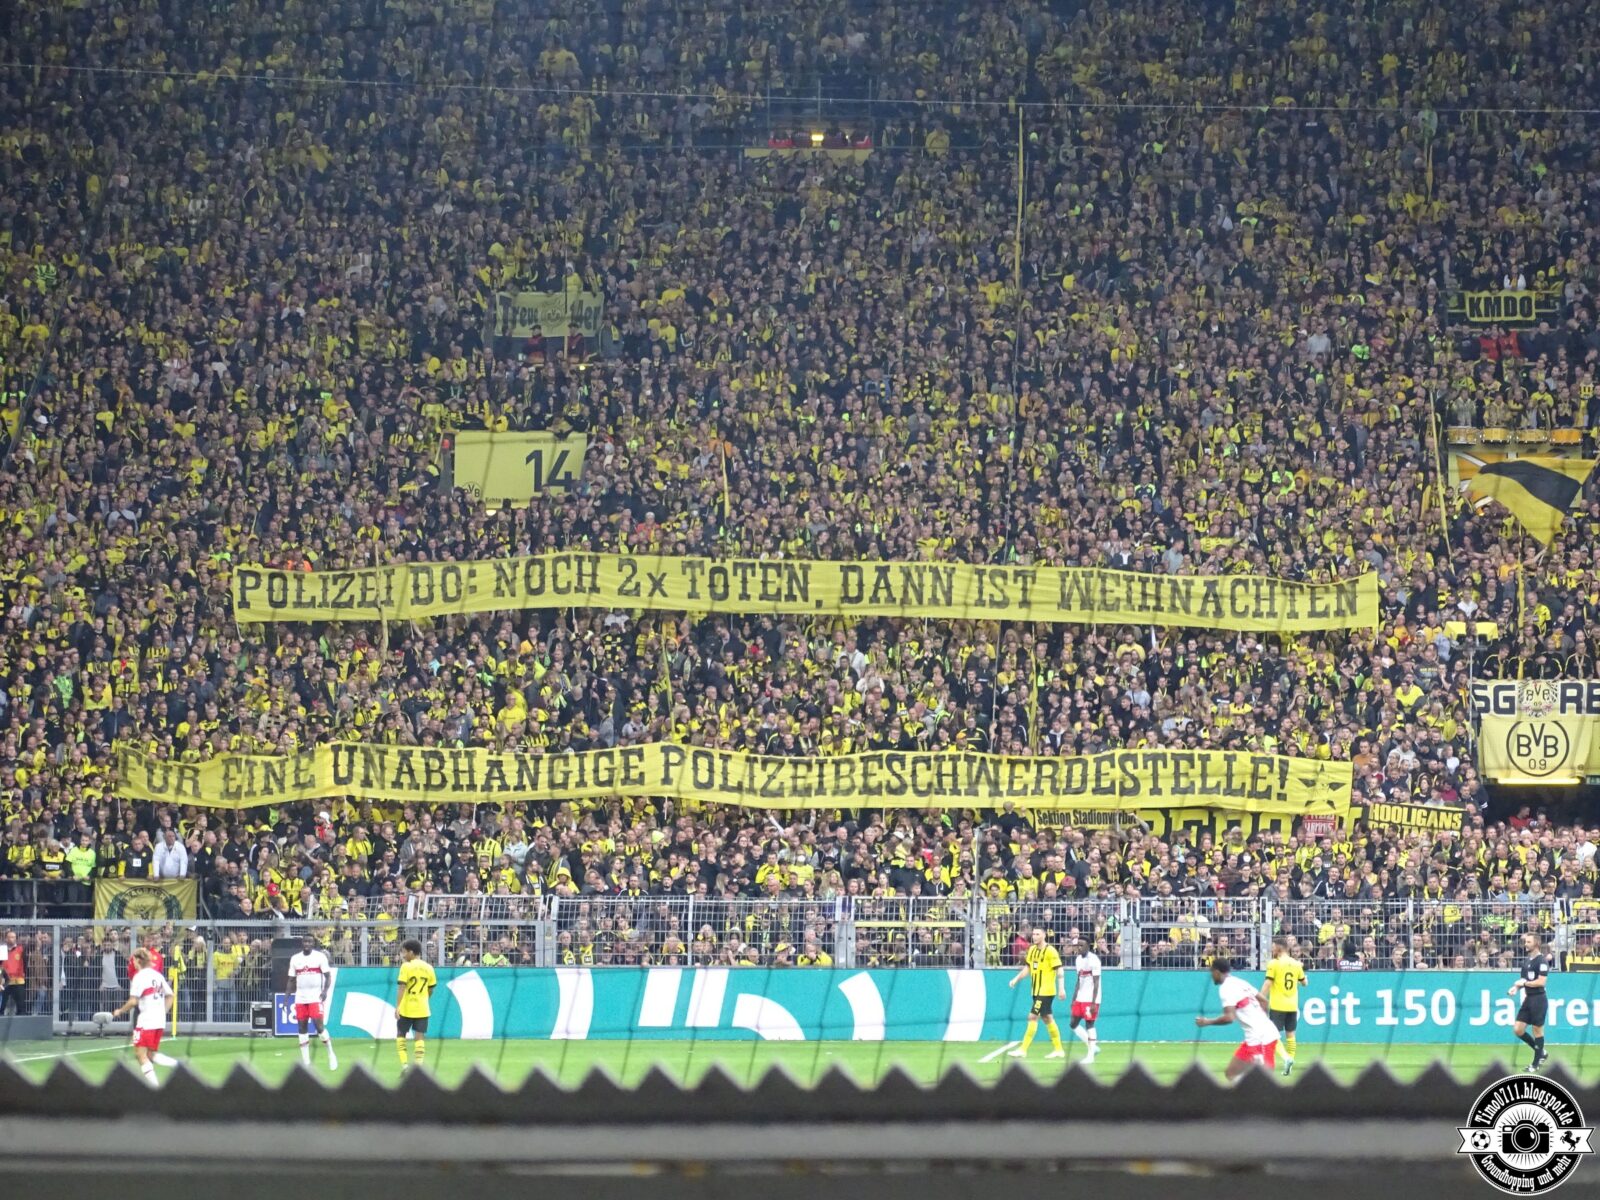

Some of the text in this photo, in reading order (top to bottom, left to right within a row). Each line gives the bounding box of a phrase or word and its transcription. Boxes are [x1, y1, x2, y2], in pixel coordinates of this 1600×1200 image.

[1468, 296, 1533, 318] KMDO
[525, 450, 582, 492] 14
[236, 568, 396, 609] POLIZEI
[409, 565, 478, 605] DO:
[493, 555, 601, 597] NOCH
[839, 564, 956, 606] DANN
[973, 568, 1037, 609] IST
[1057, 570, 1360, 619] WEIHNACHTEN
[1516, 723, 1559, 758] BVB
[220, 750, 317, 801] EINE
[660, 744, 1289, 800] POLIZEIBESCHWERDESTELLE!
[1528, 758, 1547, 770] 09
[1368, 803, 1463, 831] HOOLIGANS
[408, 976, 428, 994] 27
[1284, 972, 1294, 991] 6
[1297, 985, 1600, 1026] eit 150 Jare
